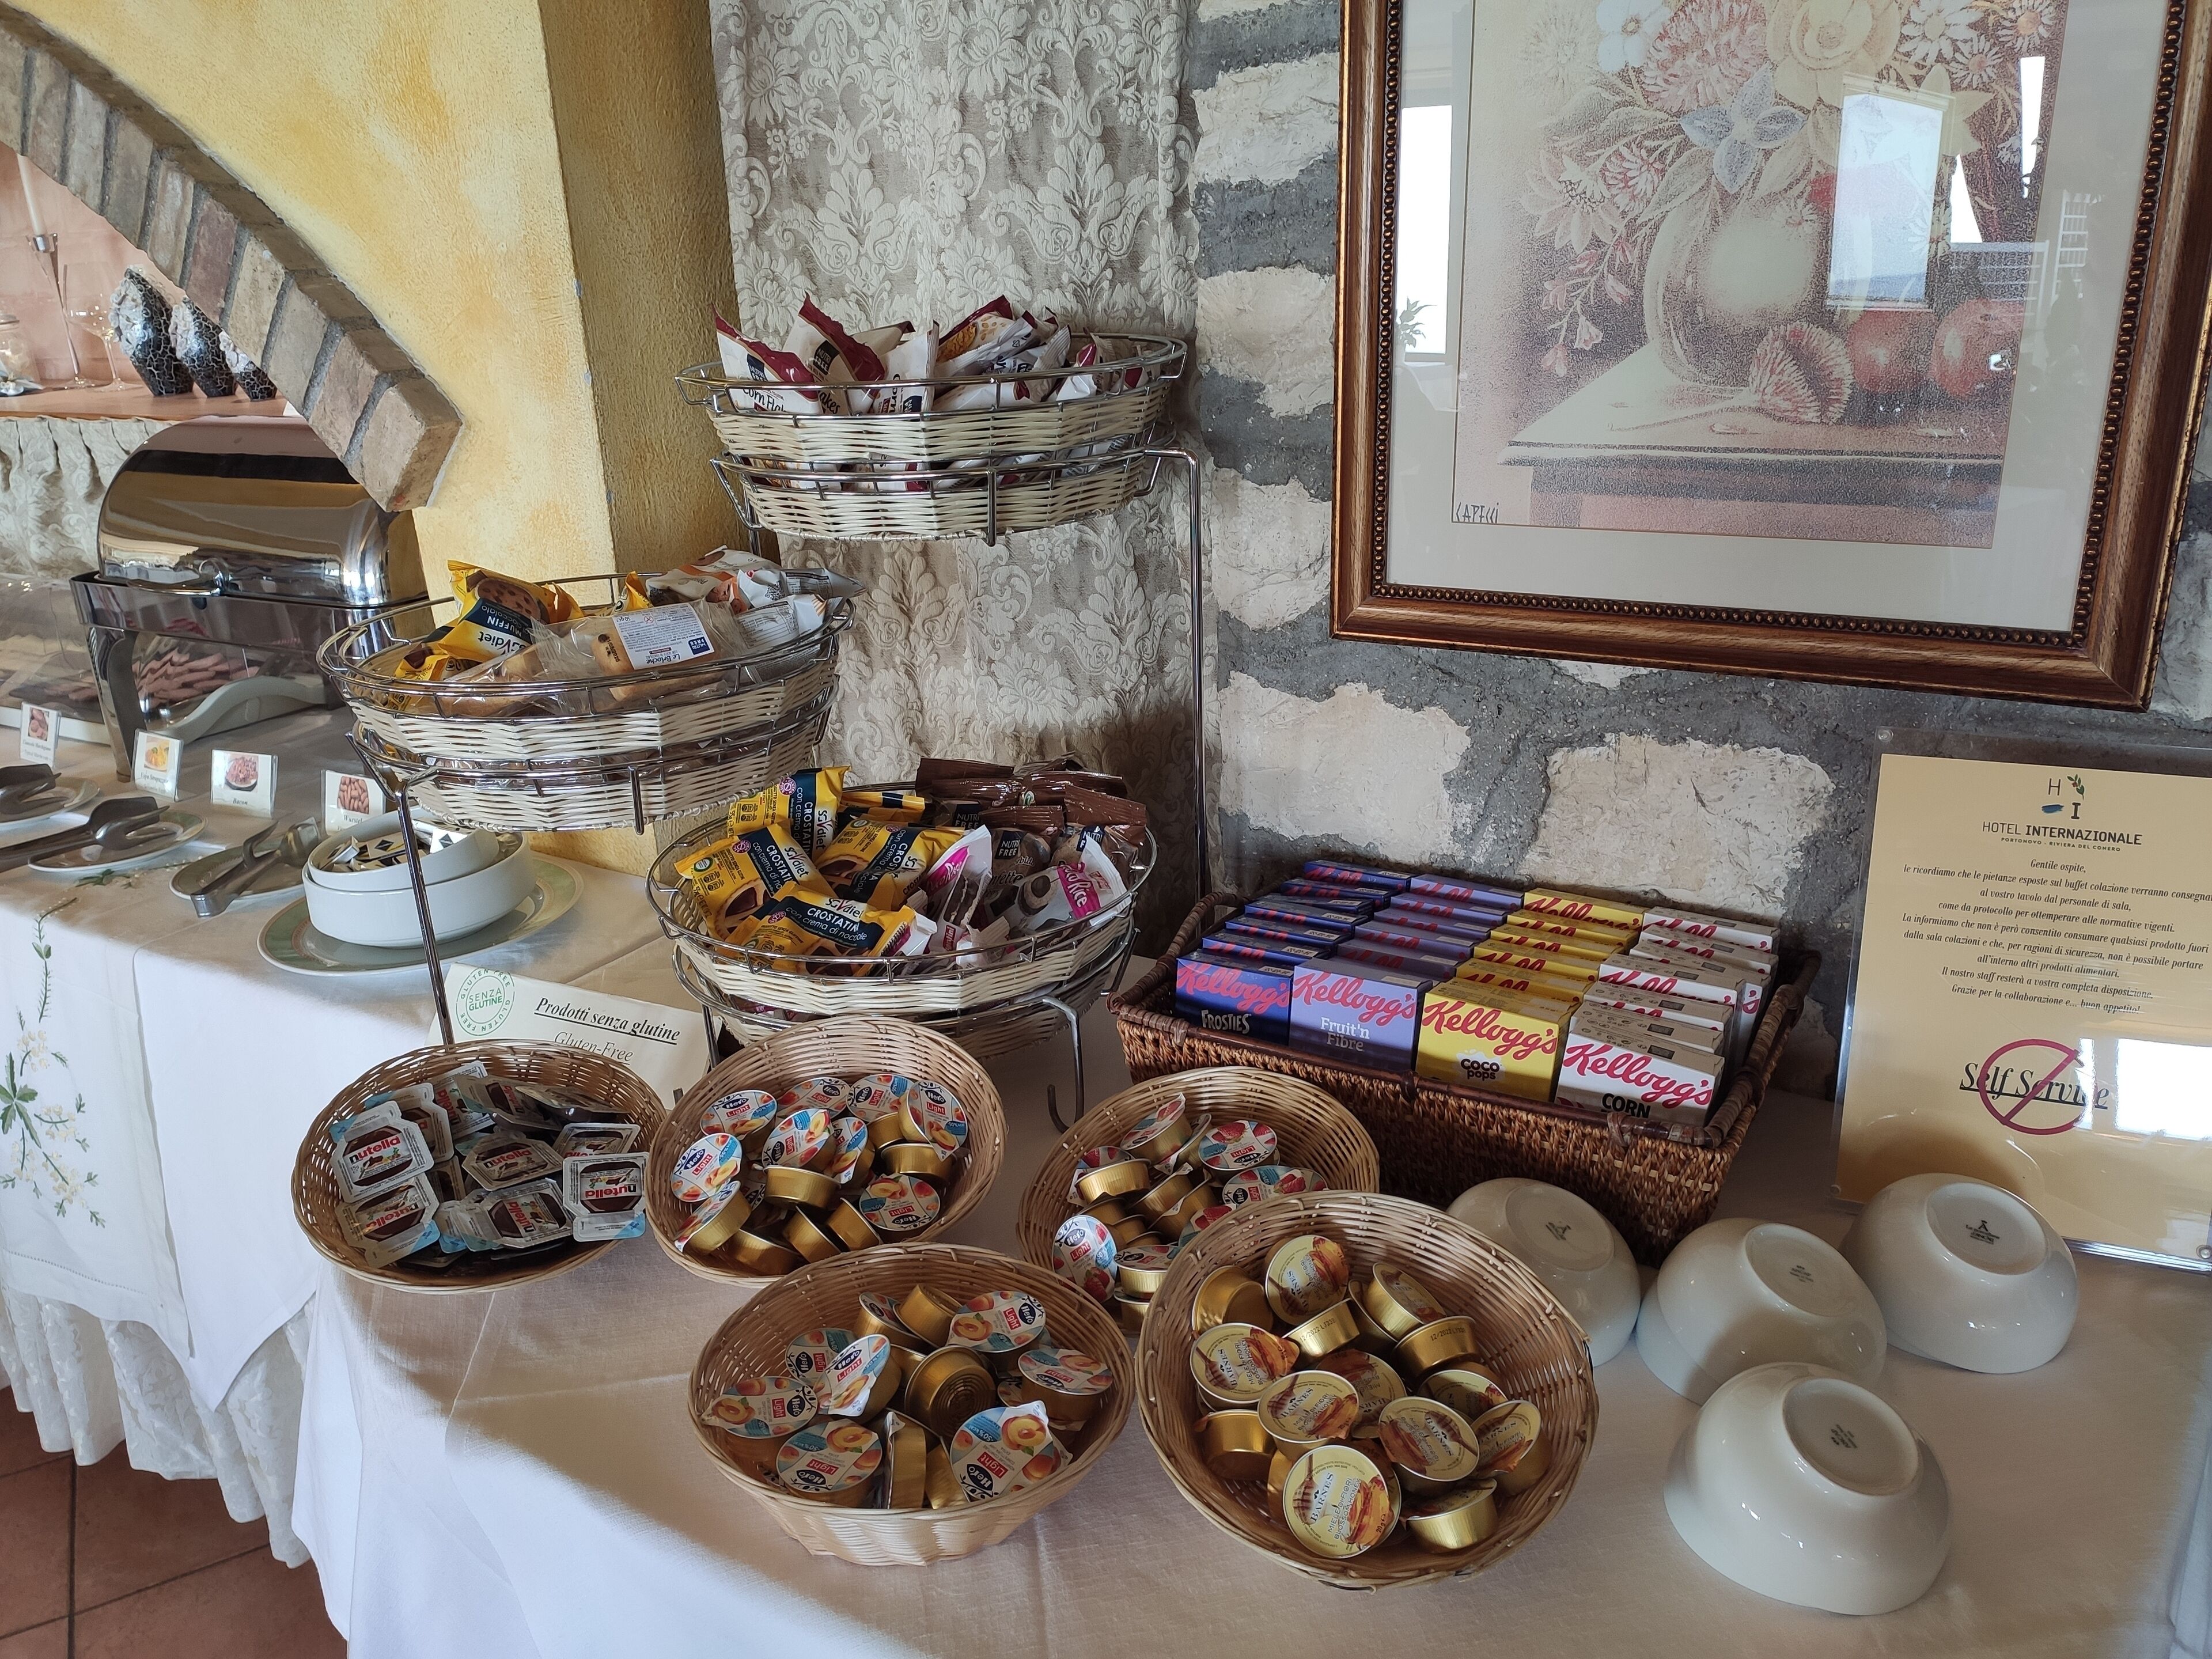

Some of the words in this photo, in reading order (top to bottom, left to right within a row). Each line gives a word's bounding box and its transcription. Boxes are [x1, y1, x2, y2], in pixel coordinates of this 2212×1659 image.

[817, 349, 832, 363] NUTRI
[487, 616, 522, 637] MUFFIN
[646, 656, 672, 665] Brioche
[2048, 778, 2061, 796] H
[2071, 802, 2081, 820] I
[1001, 839, 1020, 848] NUTRI
[1982, 821, 2021, 835] HOTEL
[2025, 824, 2143, 845] INTERNAZIONALE
[2001, 837, 2042, 845] PORTONOVO
[752, 842, 762, 853] con
[759, 852, 773, 872] crema
[766, 845, 794, 881] CROSTATI
[998, 848, 1017, 857] FREE
[2031, 858, 2058, 870] Gentile
[2060, 862, 2086, 874] ospite,
[1903, 864, 1911, 873] le
[1912, 865, 1956, 877] ricordiamo
[1957, 869, 1971, 878] che
[1974, 870, 1981, 879] le
[1982, 871, 2017, 882] pietanze
[2018, 876, 2048, 886] esposte
[2050, 878, 2062, 887] sul
[2065, 878, 2088, 891] buffet
[2090, 882, 2129, 893] colazione
[2131, 887, 2169, 897] verranno
[1067, 881, 1091, 908] Rice
[1980, 888, 1988, 897] al
[1990, 889, 2015, 899] vostro
[2017, 892, 2042, 902] tavolo
[2044, 894, 2058, 904] dal
[2059, 897, 2099, 908] personale
[2101, 899, 2110, 908] di
[2112, 902, 2131, 912] sala,
[786, 907, 802, 919] con
[802, 918, 828, 930] crema
[807, 907, 859, 932] CROSTATIN
[1938, 902, 1959, 911] come
[1961, 902, 1971, 912] da
[1973, 906, 2013, 916] protocollo
[2014, 908, 2029, 919] per
[2031, 911, 2080, 923] ottemperare
[2082, 915, 2097, 925] alle
[2100, 917, 2142, 929] normative
[2144, 921, 2175, 933] vigenti.
[1902, 912, 1912, 922] La
[1914, 914, 1959, 927] informiamo
[1961, 919, 1975, 929] che
[1976, 923, 1991, 931] non
[1994, 922, 1999, 931] è
[2000, 924, 2018, 934] però
[2021, 926, 2062, 937] consentito
[2064, 932, 2108, 942] consumare
[2110, 935, 2148, 946] qualsiasi
[2150, 939, 2186, 950] prodotto
[2186, 943, 2209, 953] fuori
[1903, 930, 1924, 940] dalla
[1926, 933, 1942, 942] sala
[1944, 935, 1981, 946] colazioni
[1988, 939, 2005, 949] che,
[2007, 942, 2021, 952] per
[2023, 944, 2052, 954] ragioni
[2054, 945, 2063, 955] di
[2065, 947, 2105, 960] sicurezza,
[2108, 953, 2123, 961] non
[2126, 952, 2131, 963] è
[2132, 954, 2170, 966] possibile
[2171, 958, 2204, 970] portare
[2021, 959, 2039, 969] altri
[2040, 962, 2073, 973] prodotti
[2075, 965, 2120, 978] alimentari.
[1176, 961, 1290, 1015] Kellogg's
[1941, 966, 1948, 975] Il
[1950, 968, 1975, 978] nostro
[1976, 972, 1997, 983] staff
[1997, 974, 2024, 984] resterà
[2034, 979, 2059, 988] vostra
[2062, 982, 2099, 993] completa
[2101, 984, 2154, 999] disposizione.
[469, 987, 502, 1003] SENZA
[469, 996, 502, 1011] GLUTINE
[1292, 971, 1416, 1027] Kellogg's
[1952, 984, 1977, 995] Grazie
[1978, 988, 1993, 998] per
[1994, 989, 2002, 998] la
[2004, 991, 2063, 1005] collaborazione
[2081, 999, 2101, 1010] buon
[2103, 1003, 2141, 1014] appetito!
[535, 997, 590, 1021] Prodotti
[590, 1013, 629, 1030] senza
[629, 1019, 680, 1041] glutine
[1201, 1009, 1250, 1035] FROSTIES
[1320, 1017, 1370, 1040] Fruit'n
[1422, 999, 1558, 1061] Kellogg's
[554, 1031, 633, 1062] Gluten-Free
[1327, 1033, 1364, 1052] Fibre
[1467, 1069, 1496, 1081] pops
[1562, 1041, 1715, 1109] Kellogg's
[725, 1097, 749, 1109] Hero
[927, 1092, 945, 1103] Hero
[1602, 1093, 1651, 1119] CORN
[728, 1105, 749, 1117] Light
[927, 1103, 946, 1115] Light
[349, 1135, 401, 1164] nutella
[484, 1149, 531, 1169] nutella
[687, 1149, 704, 1170] Hero
[1231, 1146, 1254, 1158] Light
[694, 1154, 712, 1175] Light
[585, 1184, 637, 1198] nutella
[1237, 1189, 1246, 1203] Hero
[1249, 1188, 1261, 1202] Light
[365, 1203, 419, 1230] nutella
[506, 1201, 536, 1233] nutella
[889, 1207, 914, 1216] Light
[894, 1215, 917, 1224] Hero
[1067, 1229, 1084, 1245] Hero
[1071, 1243, 1090, 1259] Light
[1005, 1309, 1021, 1329] Light
[1021, 1306, 1033, 1324] Hero
[815, 1353, 826, 1372] Light
[838, 1350, 862, 1369] Hero
[838, 1359, 862, 1381] Light
[1218, 1349, 1238, 1386] BARNES
[773, 1399, 784, 1417] Light
[791, 1398, 801, 1415] Hero
[1281, 1388, 1313, 1418] BARNES
[808, 1460, 839, 1475] Light
[979, 1453, 1007, 1478] Light
[798, 1471, 824, 1484] Hero
[968, 1465, 993, 1488] Hero
[1310, 1472, 1334, 1522] BARNES
[1328, 1506, 1340, 1533] MIELE
[1340, 1478, 1353, 1498] FIORI
[1334, 1504, 1351, 1539] BLOSSOM
[1349, 1479, 1361, 1505] HONEY
